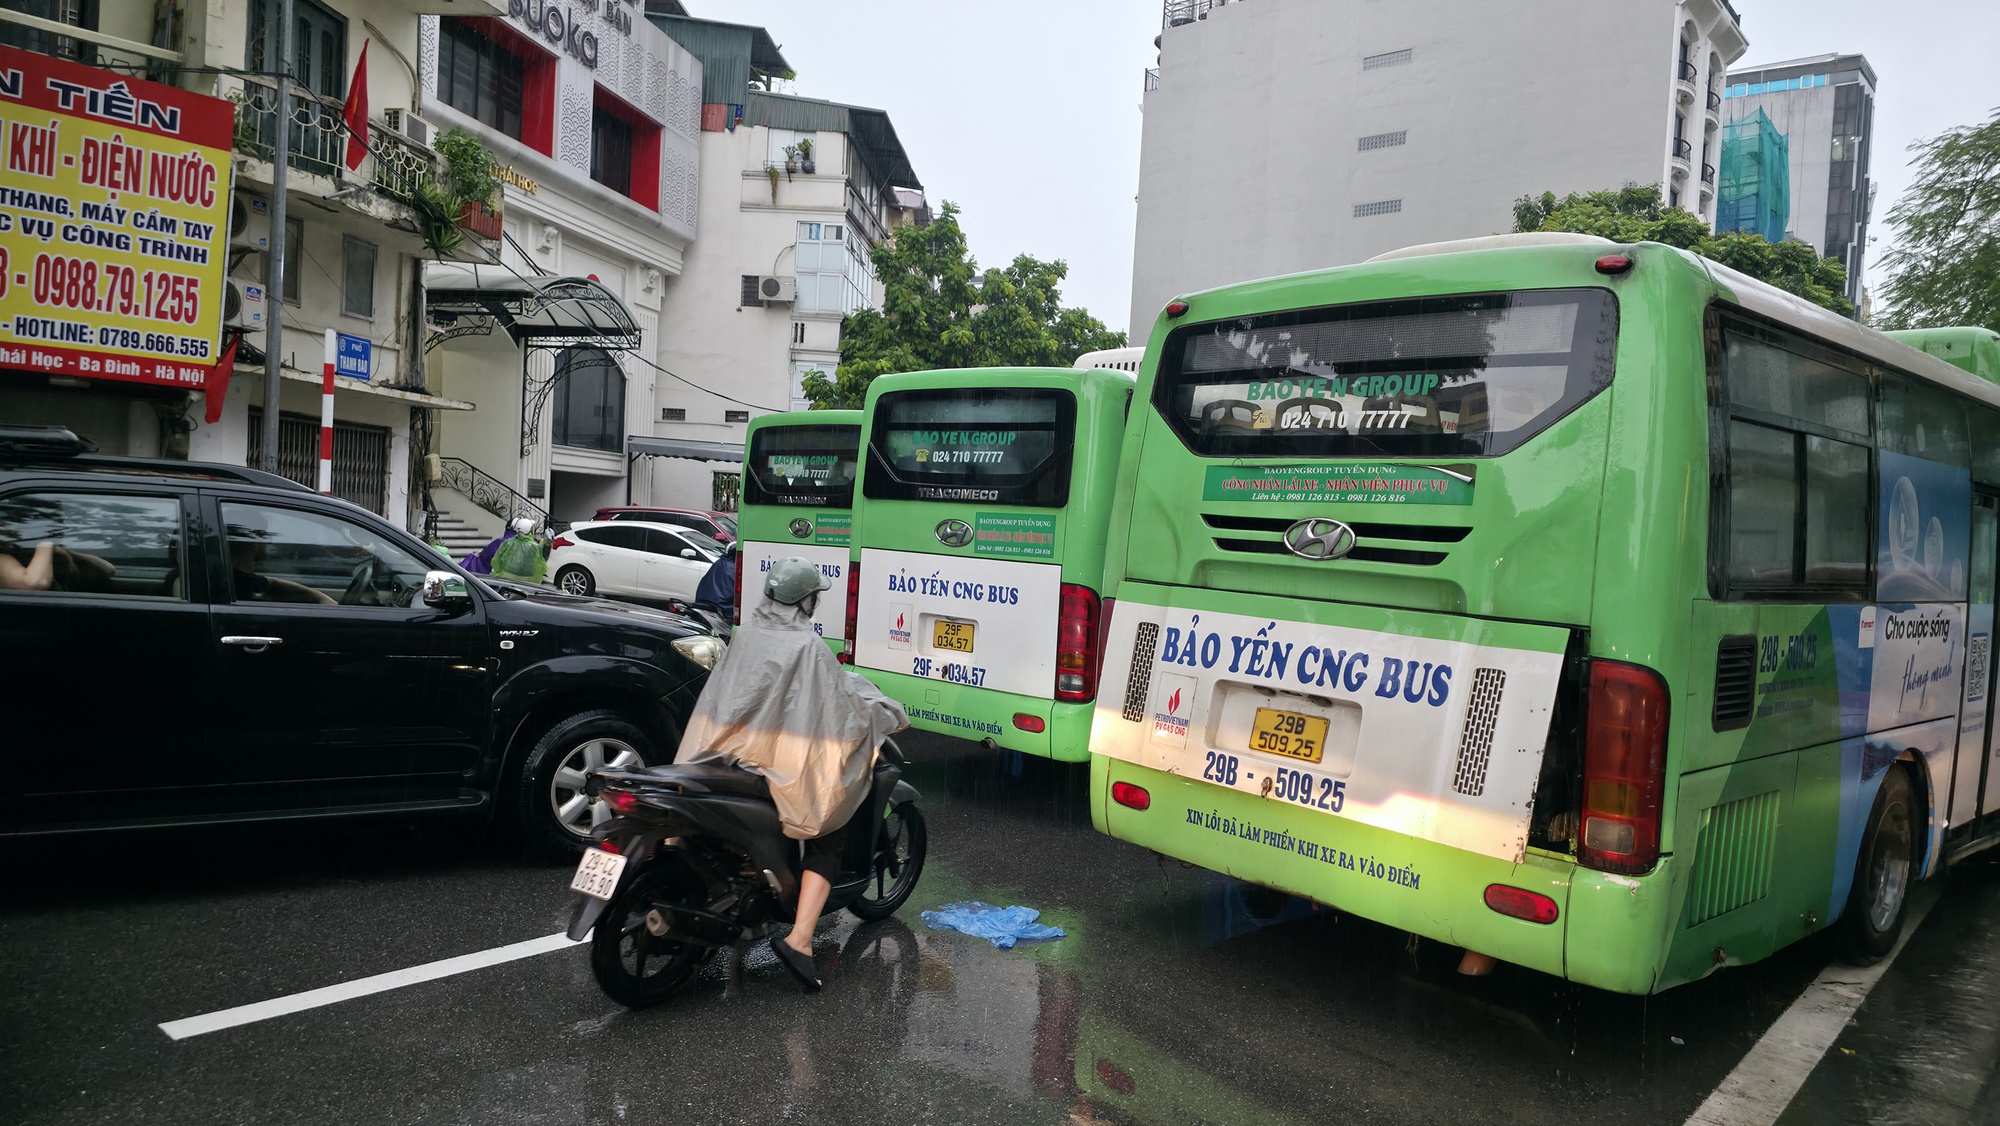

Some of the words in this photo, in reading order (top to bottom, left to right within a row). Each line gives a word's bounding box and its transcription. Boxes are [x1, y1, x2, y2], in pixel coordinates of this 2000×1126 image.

[49, 80, 178, 132] TIẾN
[9, 120, 58, 177] KHÍ
[82, 134, 143, 200] ĐIỆN
[149, 151, 216, 208] NƯỚC
[517, 174, 539, 197] HỌC
[0, 187, 74, 218] THANG,
[82, 202, 127, 225] MÁY
[133, 208, 177, 235] CẦM
[183, 221, 214, 241] TAY
[21, 217, 54, 241] VỤ
[62, 225, 130, 251] CÔNG
[139, 237, 208, 264] TRÌNH
[34, 253, 199, 325] 0988.79.1255
[15, 316, 94, 344] HOTLINE:
[99, 326, 209, 358] 0789.666.555
[31, 350, 63, 370] Học
[79, 356, 101, 372] Ba
[105, 358, 141, 377] Đình
[155, 364, 175, 380] Hà
[179, 367, 205, 385] Nội
[340, 354, 357, 371] THANH
[1247, 380, 1294, 401] BAO
[1352, 373, 1439, 397] GROUP
[1281, 410, 1312, 429] 024
[1316, 410, 1348, 429] 710
[1354, 410, 1413, 429] 77777
[912, 431, 940, 445] BAO
[971, 431, 1017, 446] GROUP
[774, 455, 790, 466] BAO
[810, 456, 839, 466] GROUP
[932, 451, 950, 463] 024
[952, 451, 971, 463] 710
[973, 451, 1004, 463] 77777
[1264, 466, 1332, 475] BAOYENGROUP
[1367, 466, 1397, 475] DỤNG
[918, 487, 999, 501] TRACOMECO
[1222, 476, 1251, 491] CÔNG
[1251, 476, 1281, 491] NHÂN
[1282, 475, 1302, 491] LÁI
[1303, 479, 1319, 491] XE
[1325, 476, 1359, 492] NHÂN
[1361, 476, 1390, 492] VIÊN
[1391, 479, 1428, 495] PHỤC
[1429, 479, 1449, 496] VỤ
[1251, 492, 1269, 500] Liên
[1270, 493, 1280, 501] hệ
[1286, 493, 1306, 501] 0981
[1307, 493, 1322, 501] 126
[1323, 493, 1340, 501] 813
[1346, 493, 1367, 502] 0981
[1370, 494, 1387, 502] 126
[1388, 494, 1406, 503] 816
[822, 564, 841, 578] BUS
[888, 567, 917, 594] BẢO
[920, 570, 950, 598] YẾN
[952, 581, 984, 601] CNG
[987, 584, 1019, 605] BUS
[944, 623, 962, 636] 29F
[1885, 614, 1904, 640] Cho
[1906, 612, 1929, 646] cuộc
[1929, 609, 1951, 643] sống
[937, 635, 969, 650] 034.57
[1760, 635, 1779, 673] 29B
[913, 657, 932, 677] 29F
[947, 663, 986, 687] 034.57
[1161, 614, 1221, 669] BẢO
[1228, 621, 1294, 680] YẾN
[1296, 645, 1370, 693] CNG
[1374, 656, 1453, 708] BUS
[1898, 654, 1929, 713] thông
[1931, 640, 1955, 683] minh
[908, 705, 921, 718] LÀM
[940, 713, 952, 725] KHI
[952, 715, 962, 727] XE
[962, 718, 971, 729] RA
[972, 719, 986, 732] VÀO
[1155, 712, 1189, 728] PETROVIETNAM
[1174, 725, 1186, 737] CNG
[1273, 714, 1306, 735] 29B
[1258, 730, 1315, 758] 509.25
[1203, 751, 1239, 786] 29B
[1275, 767, 1346, 813] 509.25
[1186, 808, 1204, 826] XIN
[1205, 809, 1221, 832] LỖI
[1222, 816, 1237, 836] ĐÃ
[1239, 821, 1261, 843] LÀM
[1262, 828, 1296, 852] PHIỀN
[1297, 839, 1319, 859] KHI
[1320, 846, 1336, 865] XE
[1338, 851, 1355, 871] RA
[1359, 856, 1385, 879] VÀO
[1387, 863, 1421, 890] ĐIỂM
